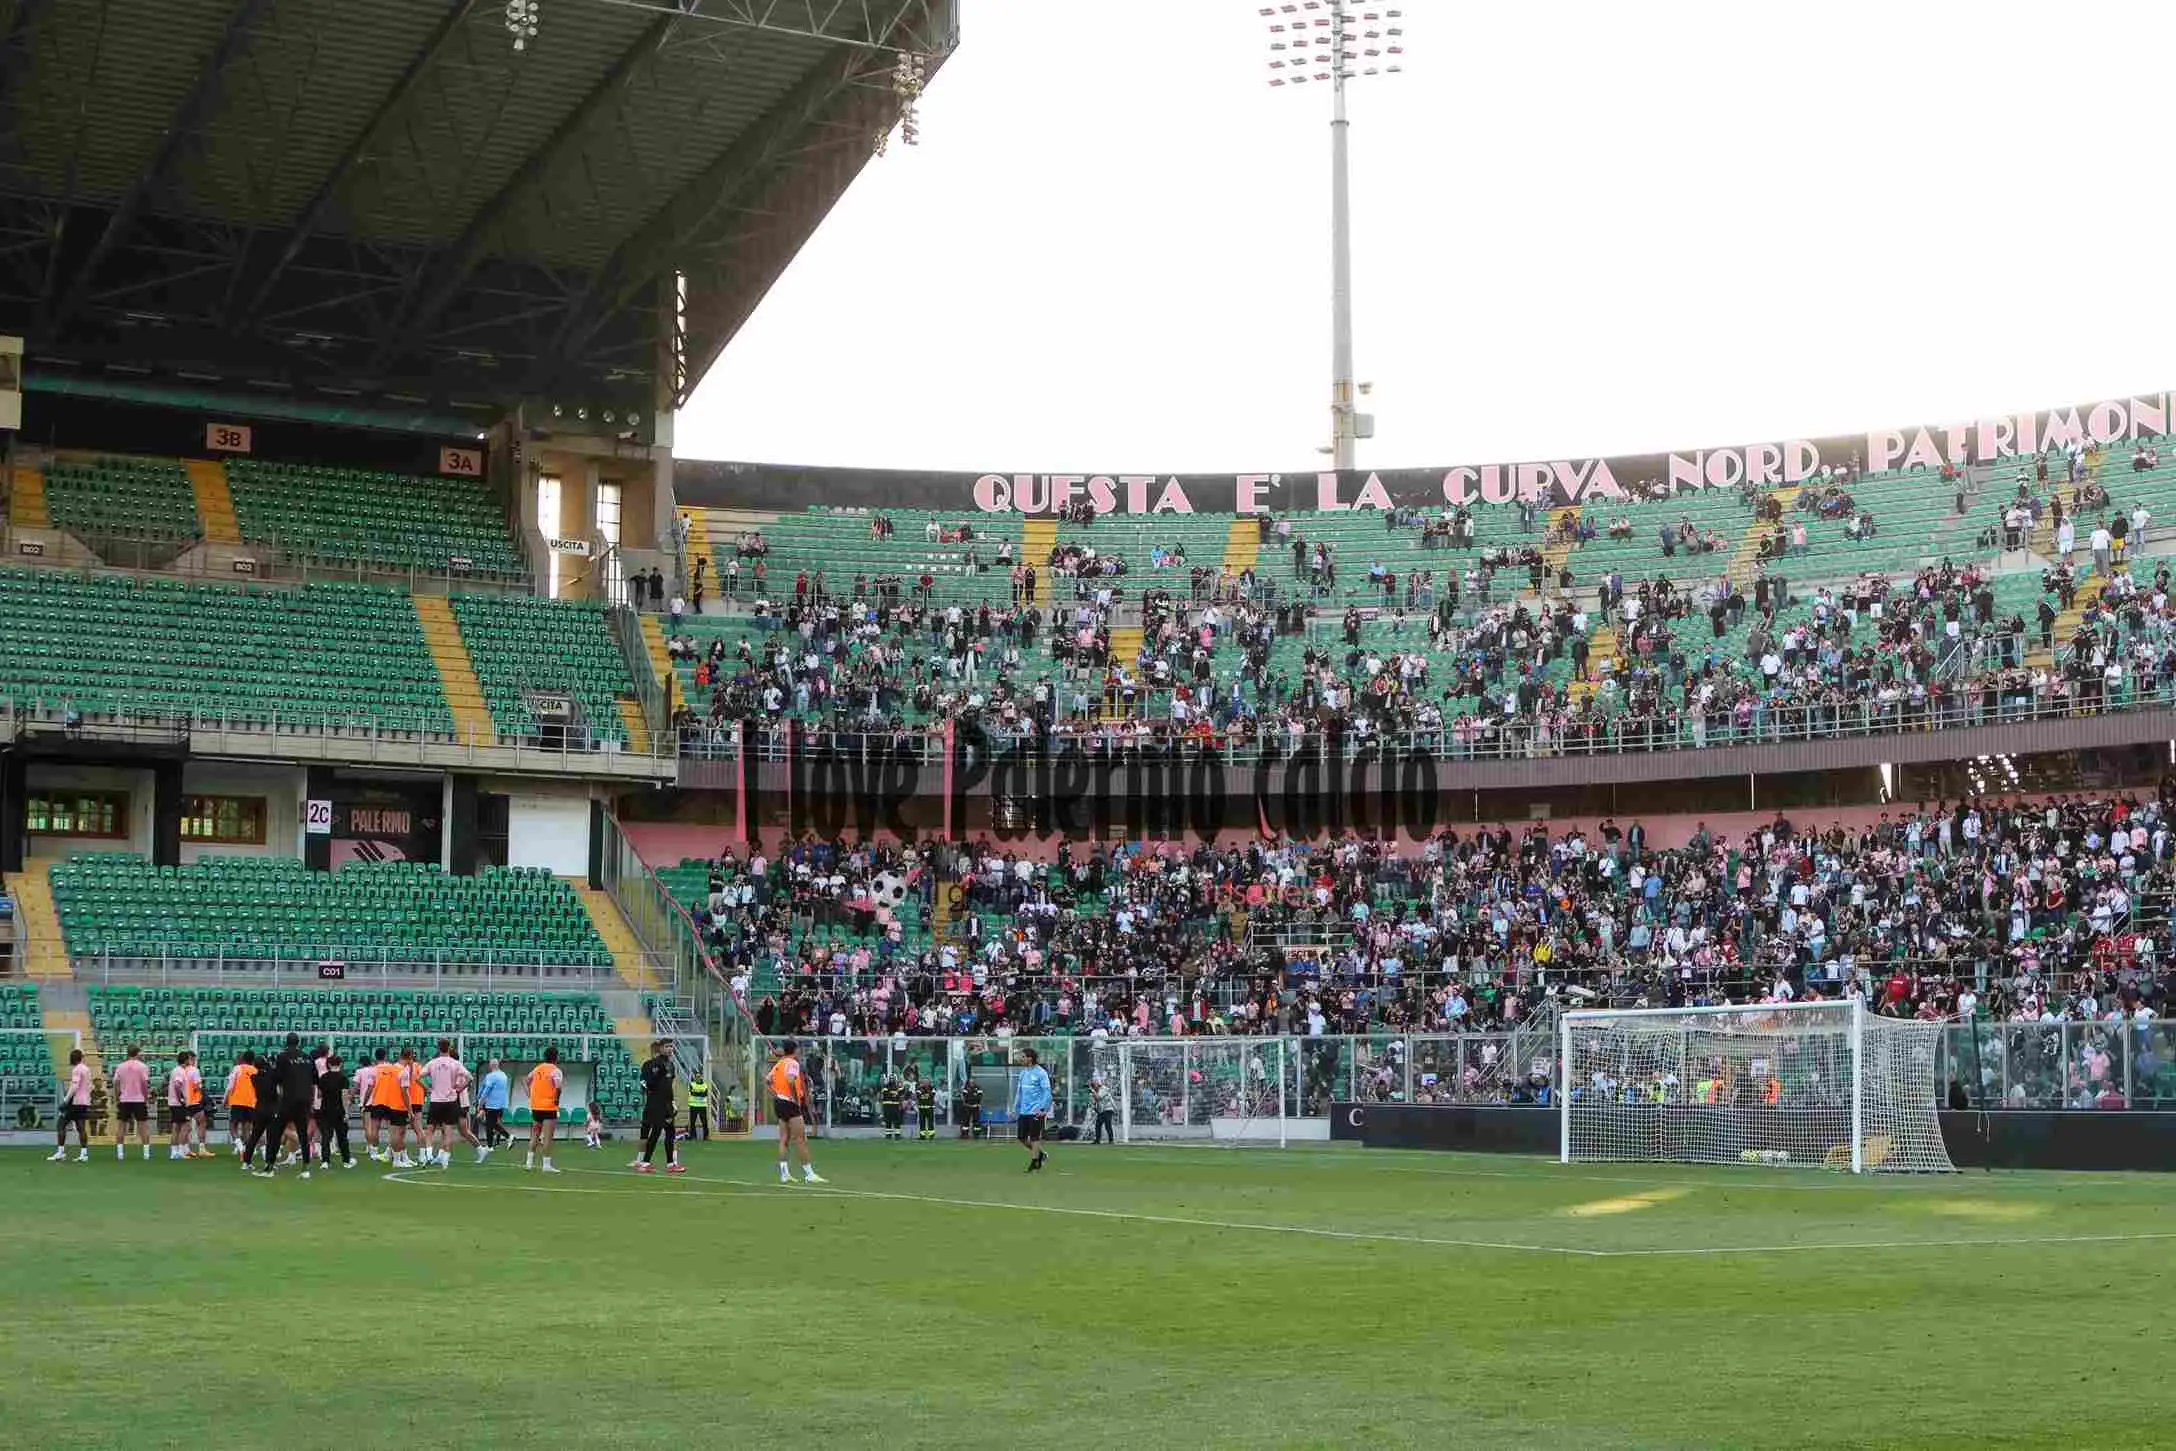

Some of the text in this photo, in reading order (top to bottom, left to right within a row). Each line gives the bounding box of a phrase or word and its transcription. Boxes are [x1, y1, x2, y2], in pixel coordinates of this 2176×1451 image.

[216, 427, 241, 448] 3B
[448, 452, 473, 472] 3A
[973, 474, 1195, 513] QUESTA
[1235, 473, 1281, 513] E'
[1317, 471, 1396, 511] LA
[1442, 457, 1631, 506] CURVA
[550, 539, 584, 551] USCITA
[530, 698, 562, 711] CITA
[309, 803, 329, 824] 2C
[351, 809, 411, 834] PALERMO
[323, 967, 341, 977] C01
[1349, 1108, 1364, 1128] C
